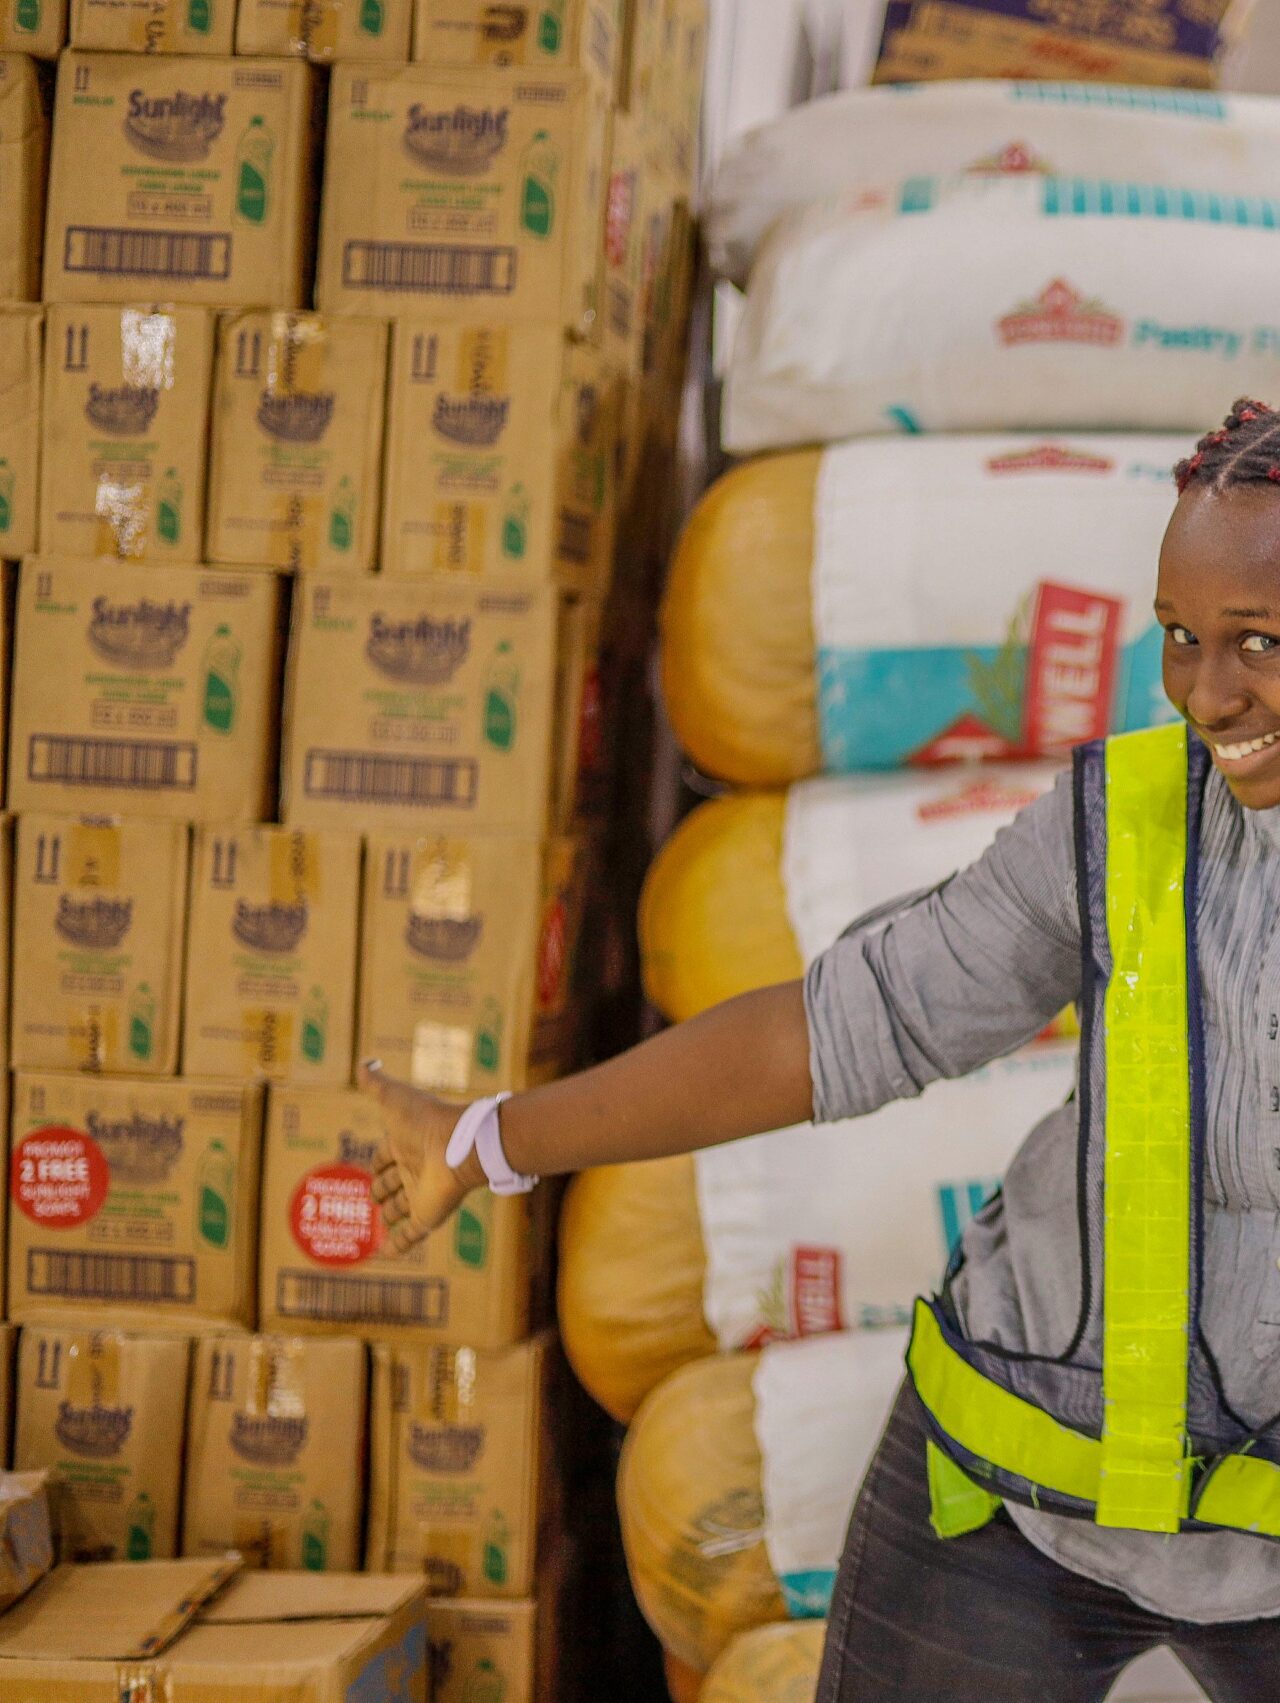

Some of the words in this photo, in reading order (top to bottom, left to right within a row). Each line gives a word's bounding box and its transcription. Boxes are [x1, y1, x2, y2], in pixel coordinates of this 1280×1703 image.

[128, 88, 228, 124] Sunlight
[406, 102, 509, 136] Sunlight
[1135, 317, 1241, 359] Pastry
[92, 596, 192, 632] Sunlight
[20, 1159, 35, 1182] 2
[38, 1158, 89, 1182] FREE
